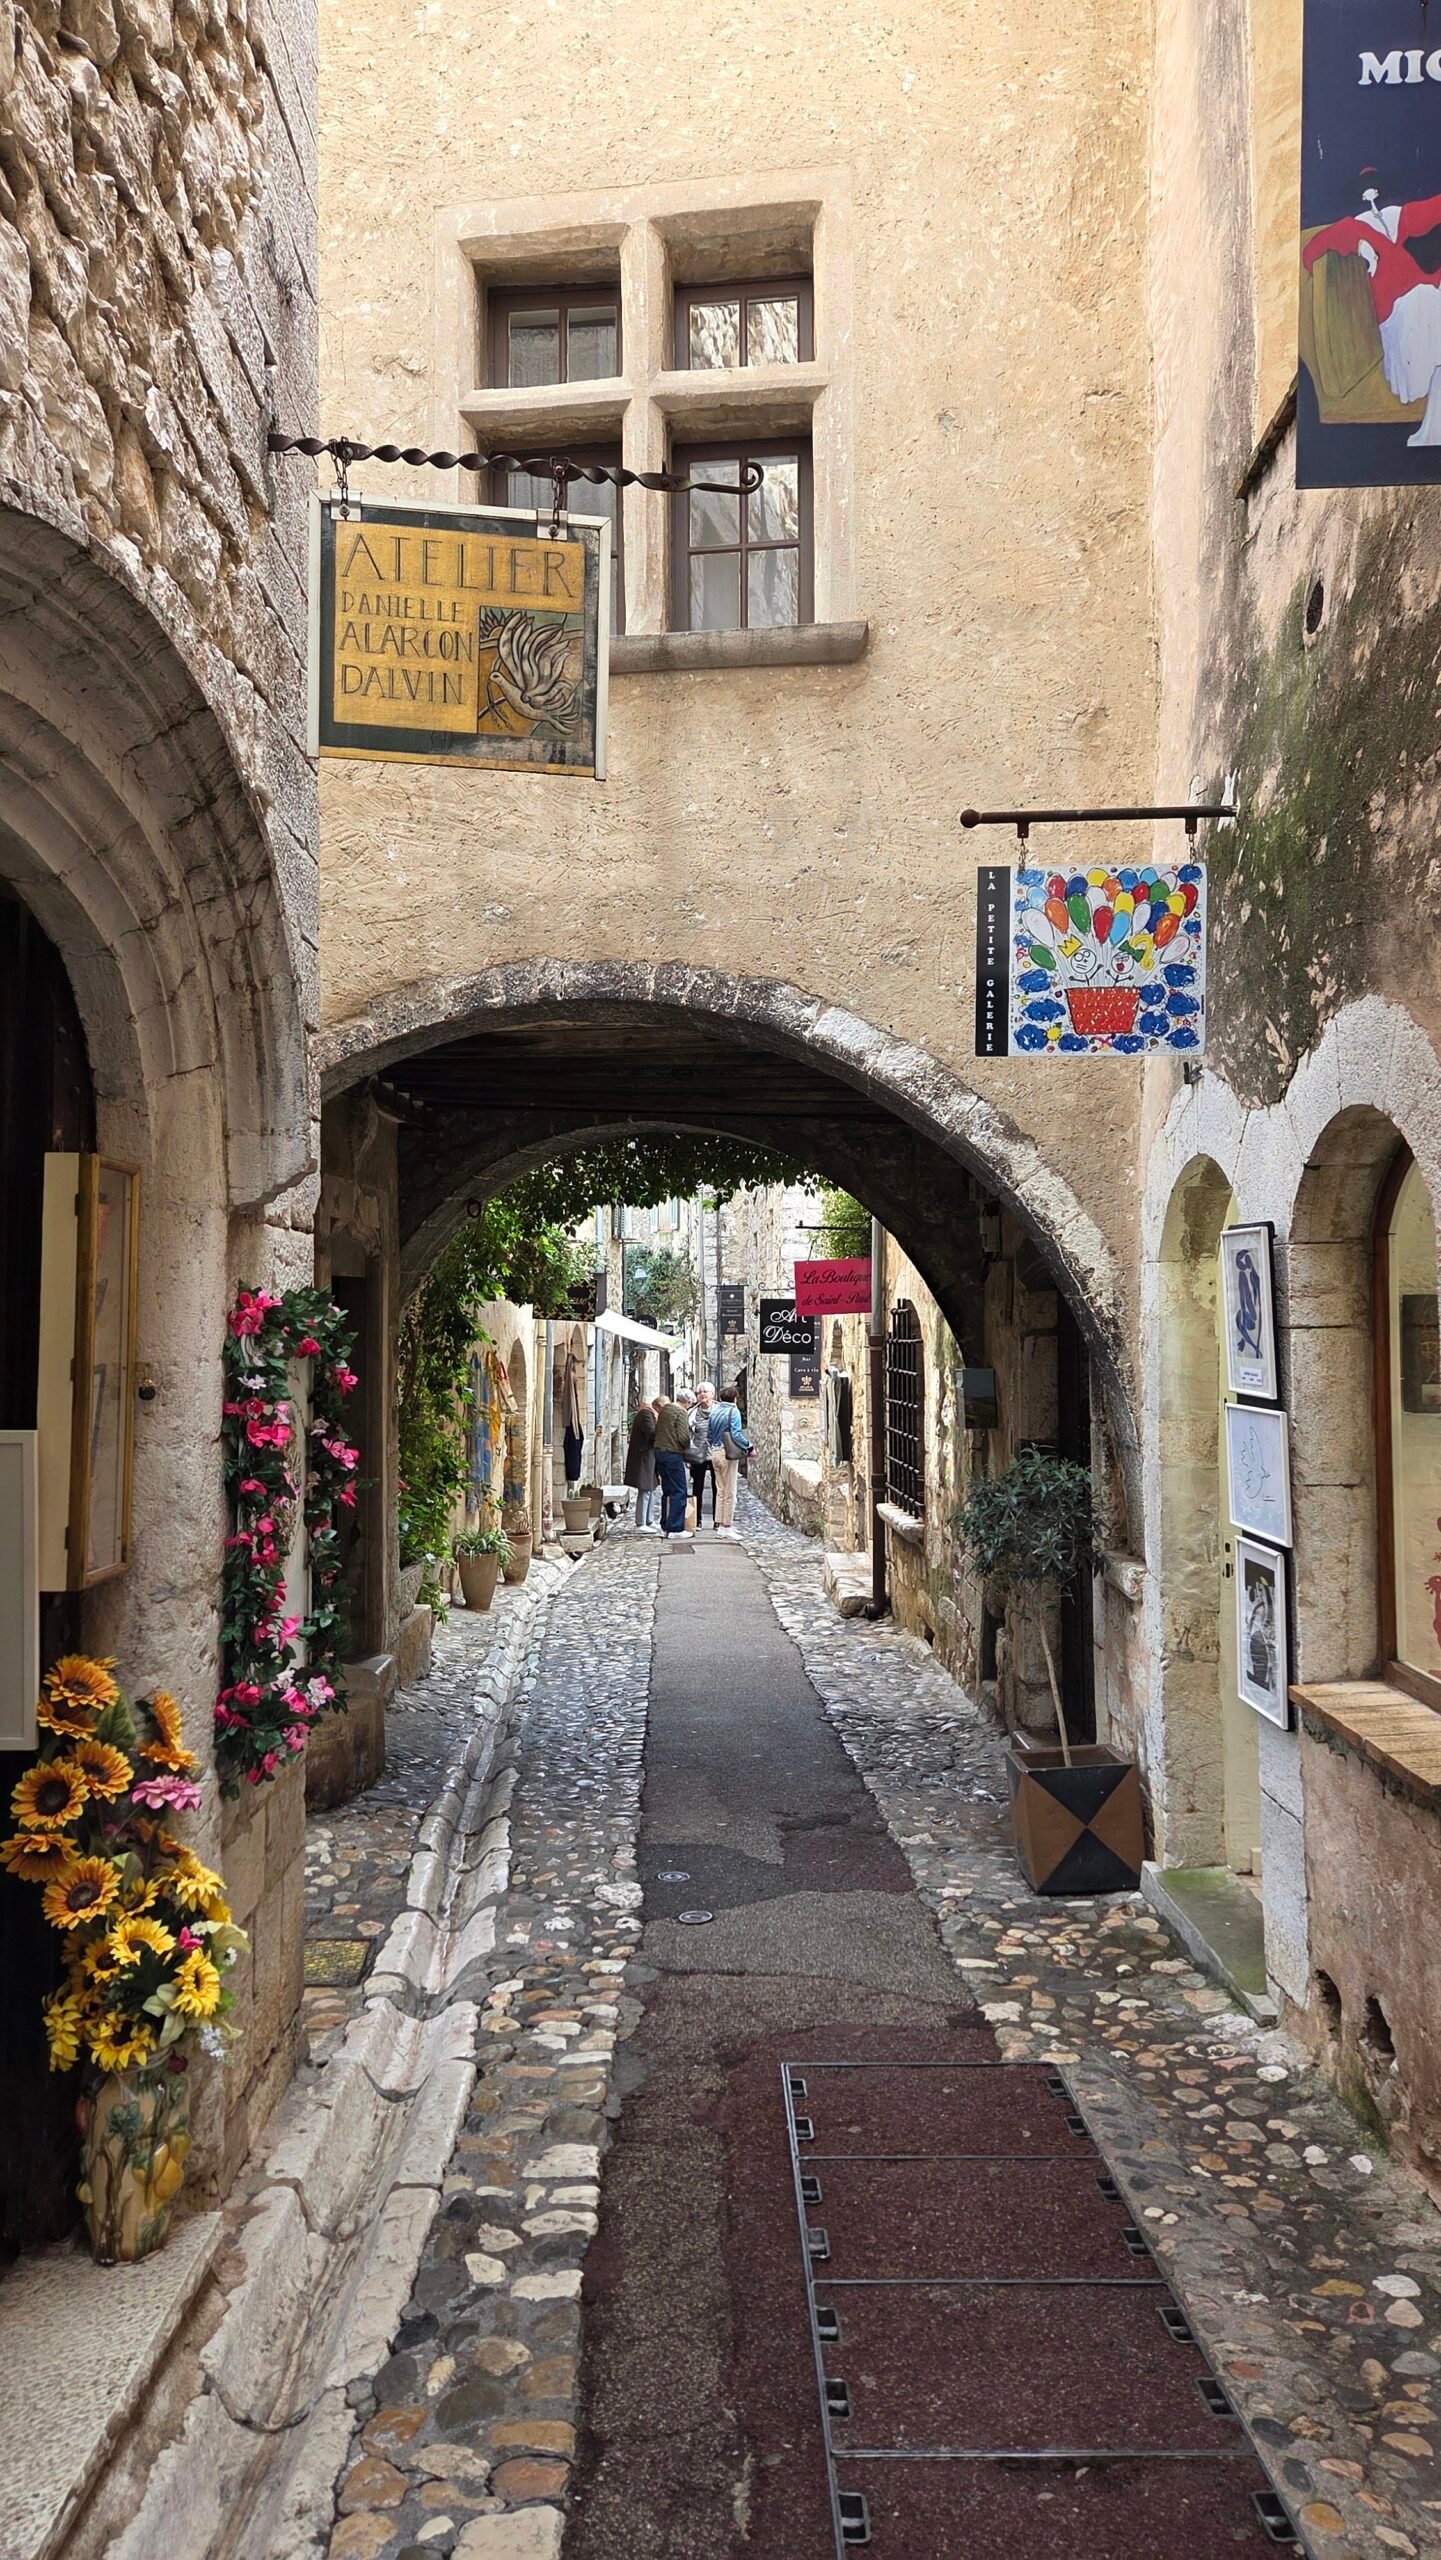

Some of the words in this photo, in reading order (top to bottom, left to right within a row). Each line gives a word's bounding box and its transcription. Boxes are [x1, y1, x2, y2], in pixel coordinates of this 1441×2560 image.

[342, 533, 575, 598] ATELIER
[341, 591, 466, 623] DANIELLE
[339, 621, 474, 663] ALARCON
[340, 663, 464, 705] DALVIN
[987, 871, 996, 891] LA
[987, 904, 996, 966] PETITE
[986, 979, 995, 1052] GALERIE
[801, 1270, 820, 1285] La
[819, 1268, 871, 1287] Boutique
[801, 1294, 814, 1306] de
[763, 1325, 812, 1344] Déco
